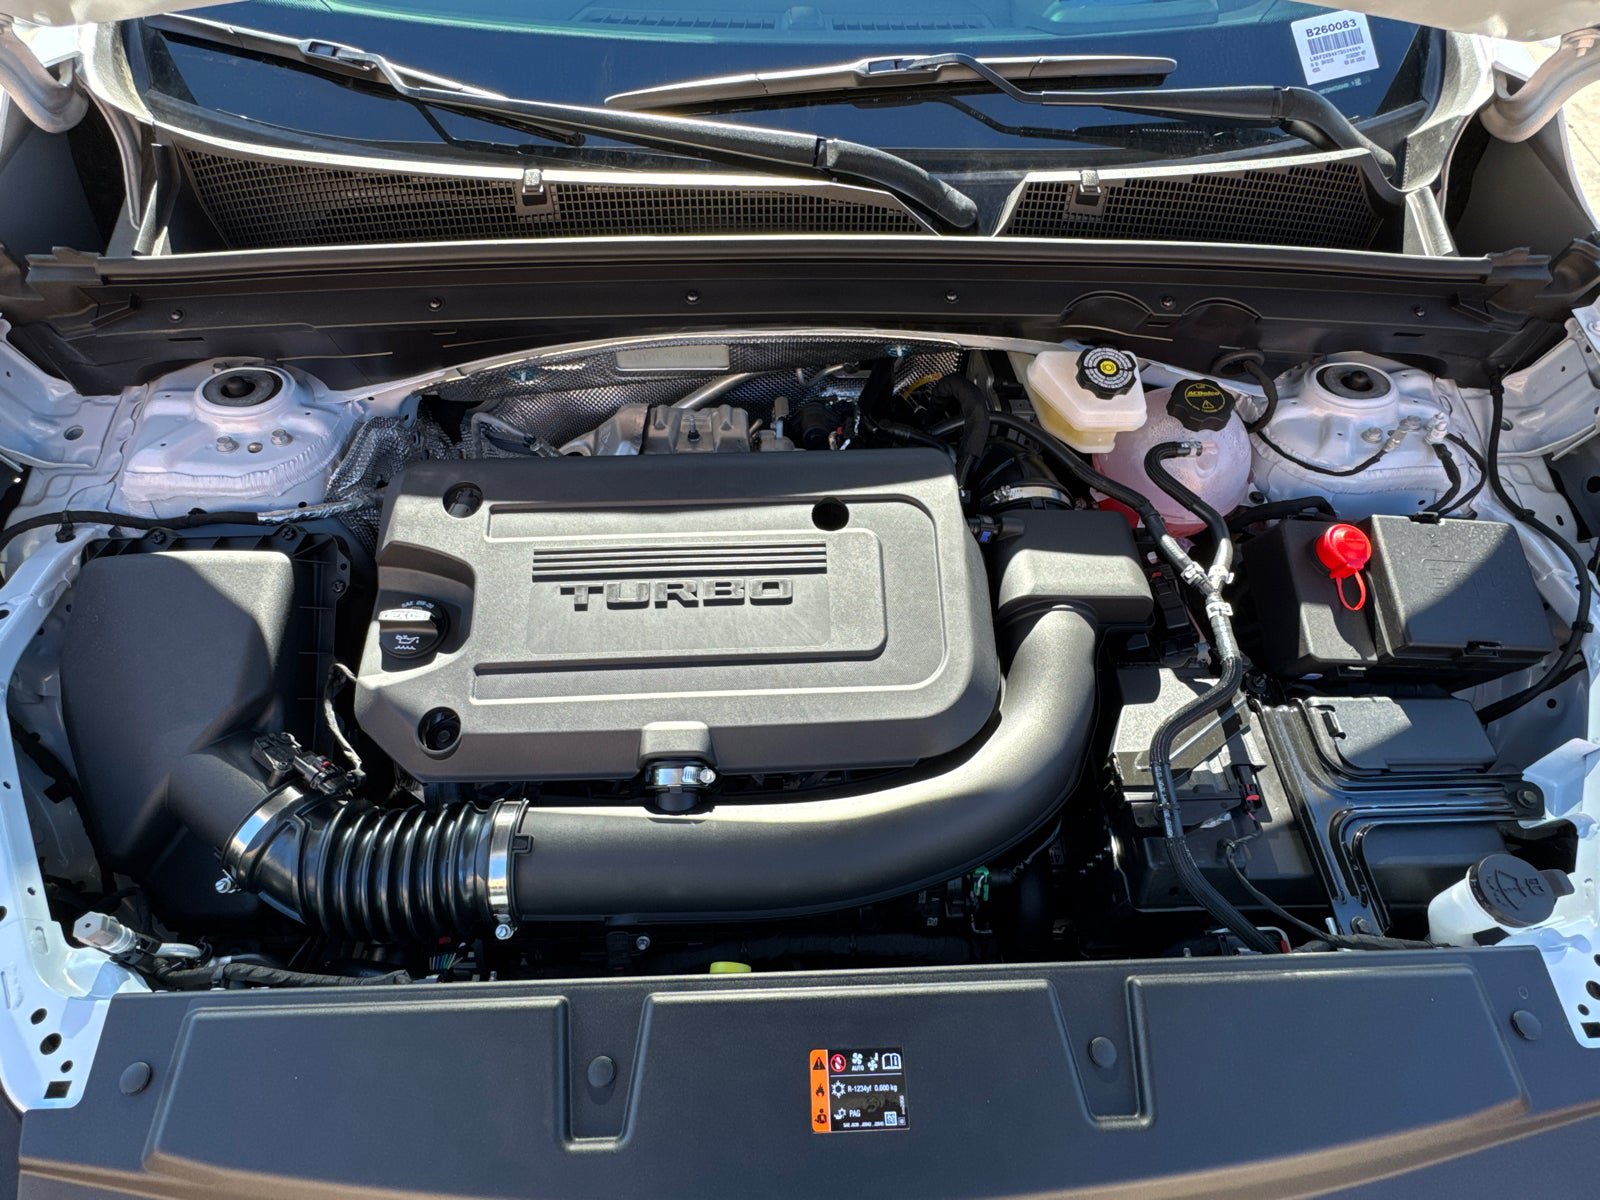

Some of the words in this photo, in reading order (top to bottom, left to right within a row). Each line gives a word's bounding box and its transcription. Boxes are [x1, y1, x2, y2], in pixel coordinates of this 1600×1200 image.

[1306, 19, 1357, 37] B260083
[560, 579, 793, 611] TURBO
[847, 1084, 872, 1094] R-1234yf
[890, 1084, 898, 1093] kg
[849, 1109, 861, 1118] PAG
